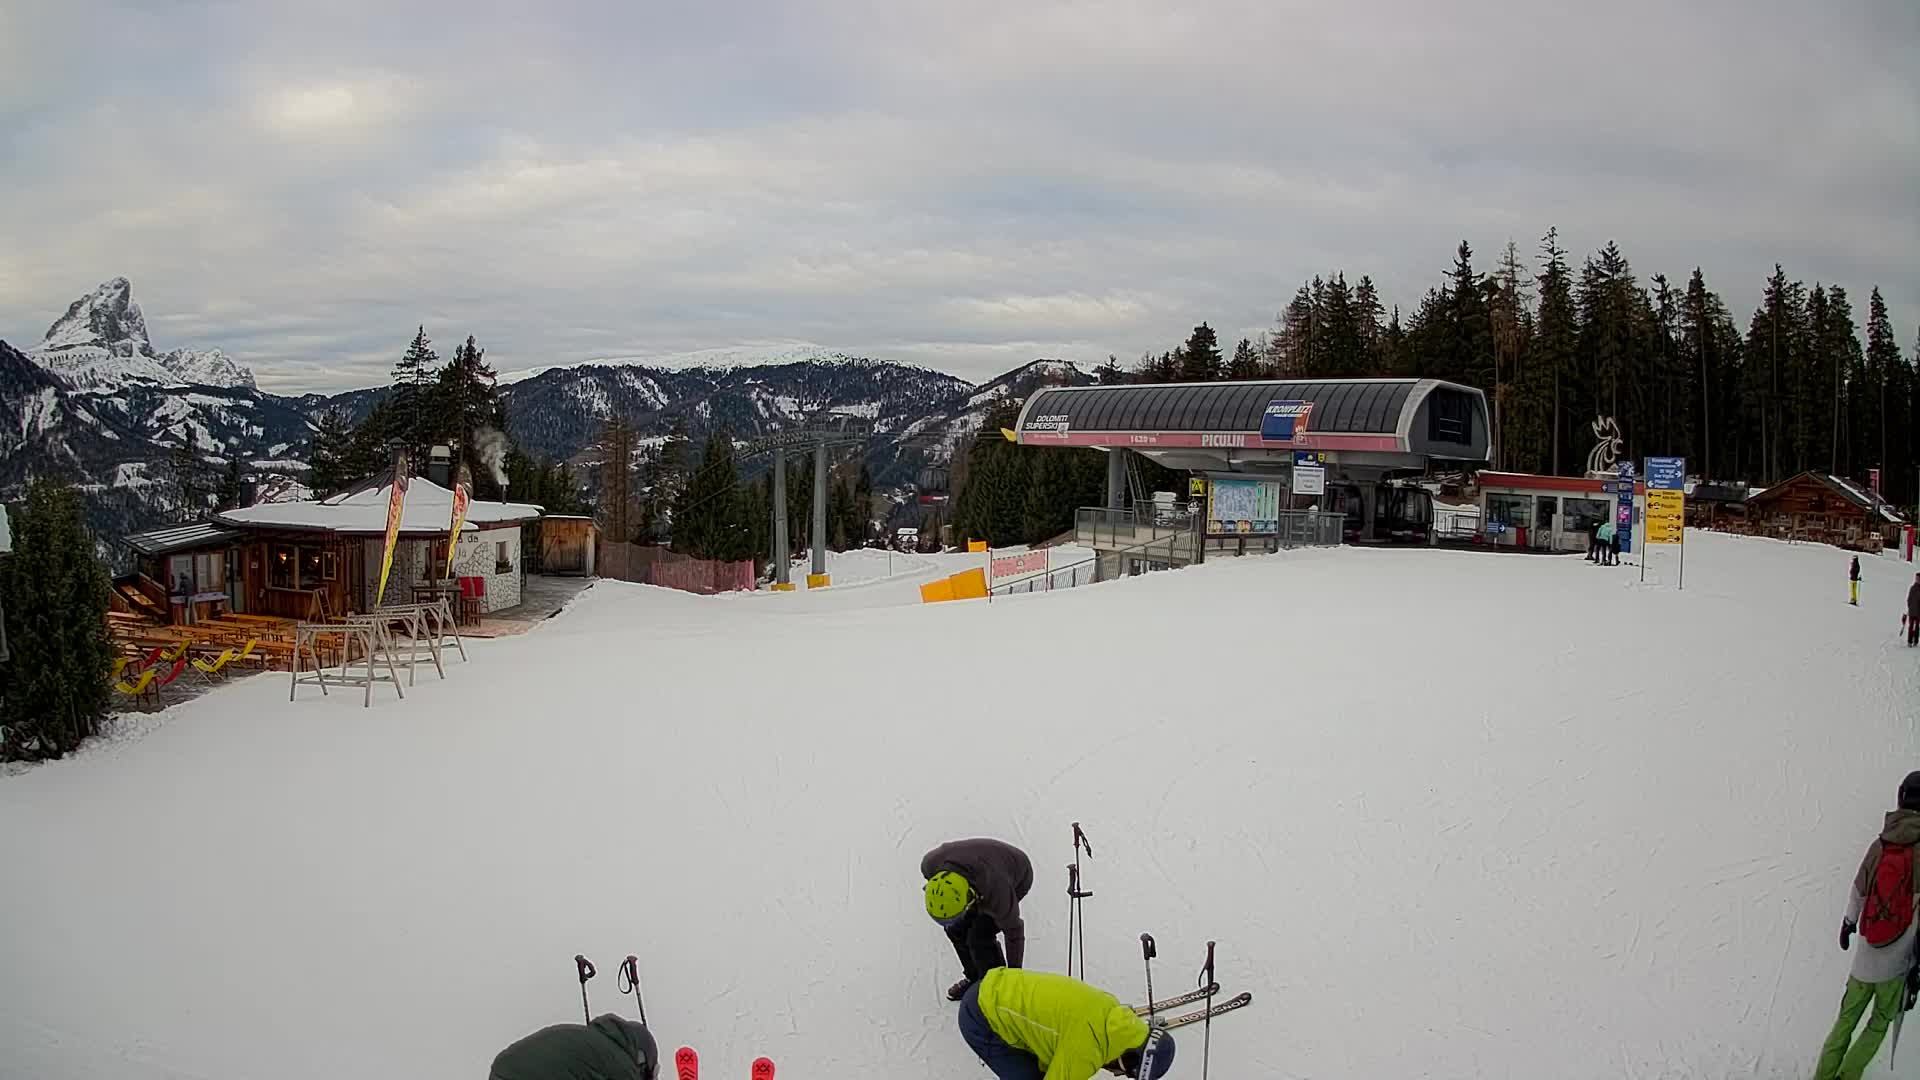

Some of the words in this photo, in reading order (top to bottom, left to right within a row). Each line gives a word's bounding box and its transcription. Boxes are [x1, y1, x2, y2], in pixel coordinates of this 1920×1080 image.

[1265, 405, 1312, 414] KRONPLATZ
[1025, 422, 1058, 430] SUPERSKI
[1201, 434, 1245, 447] PICULIN
